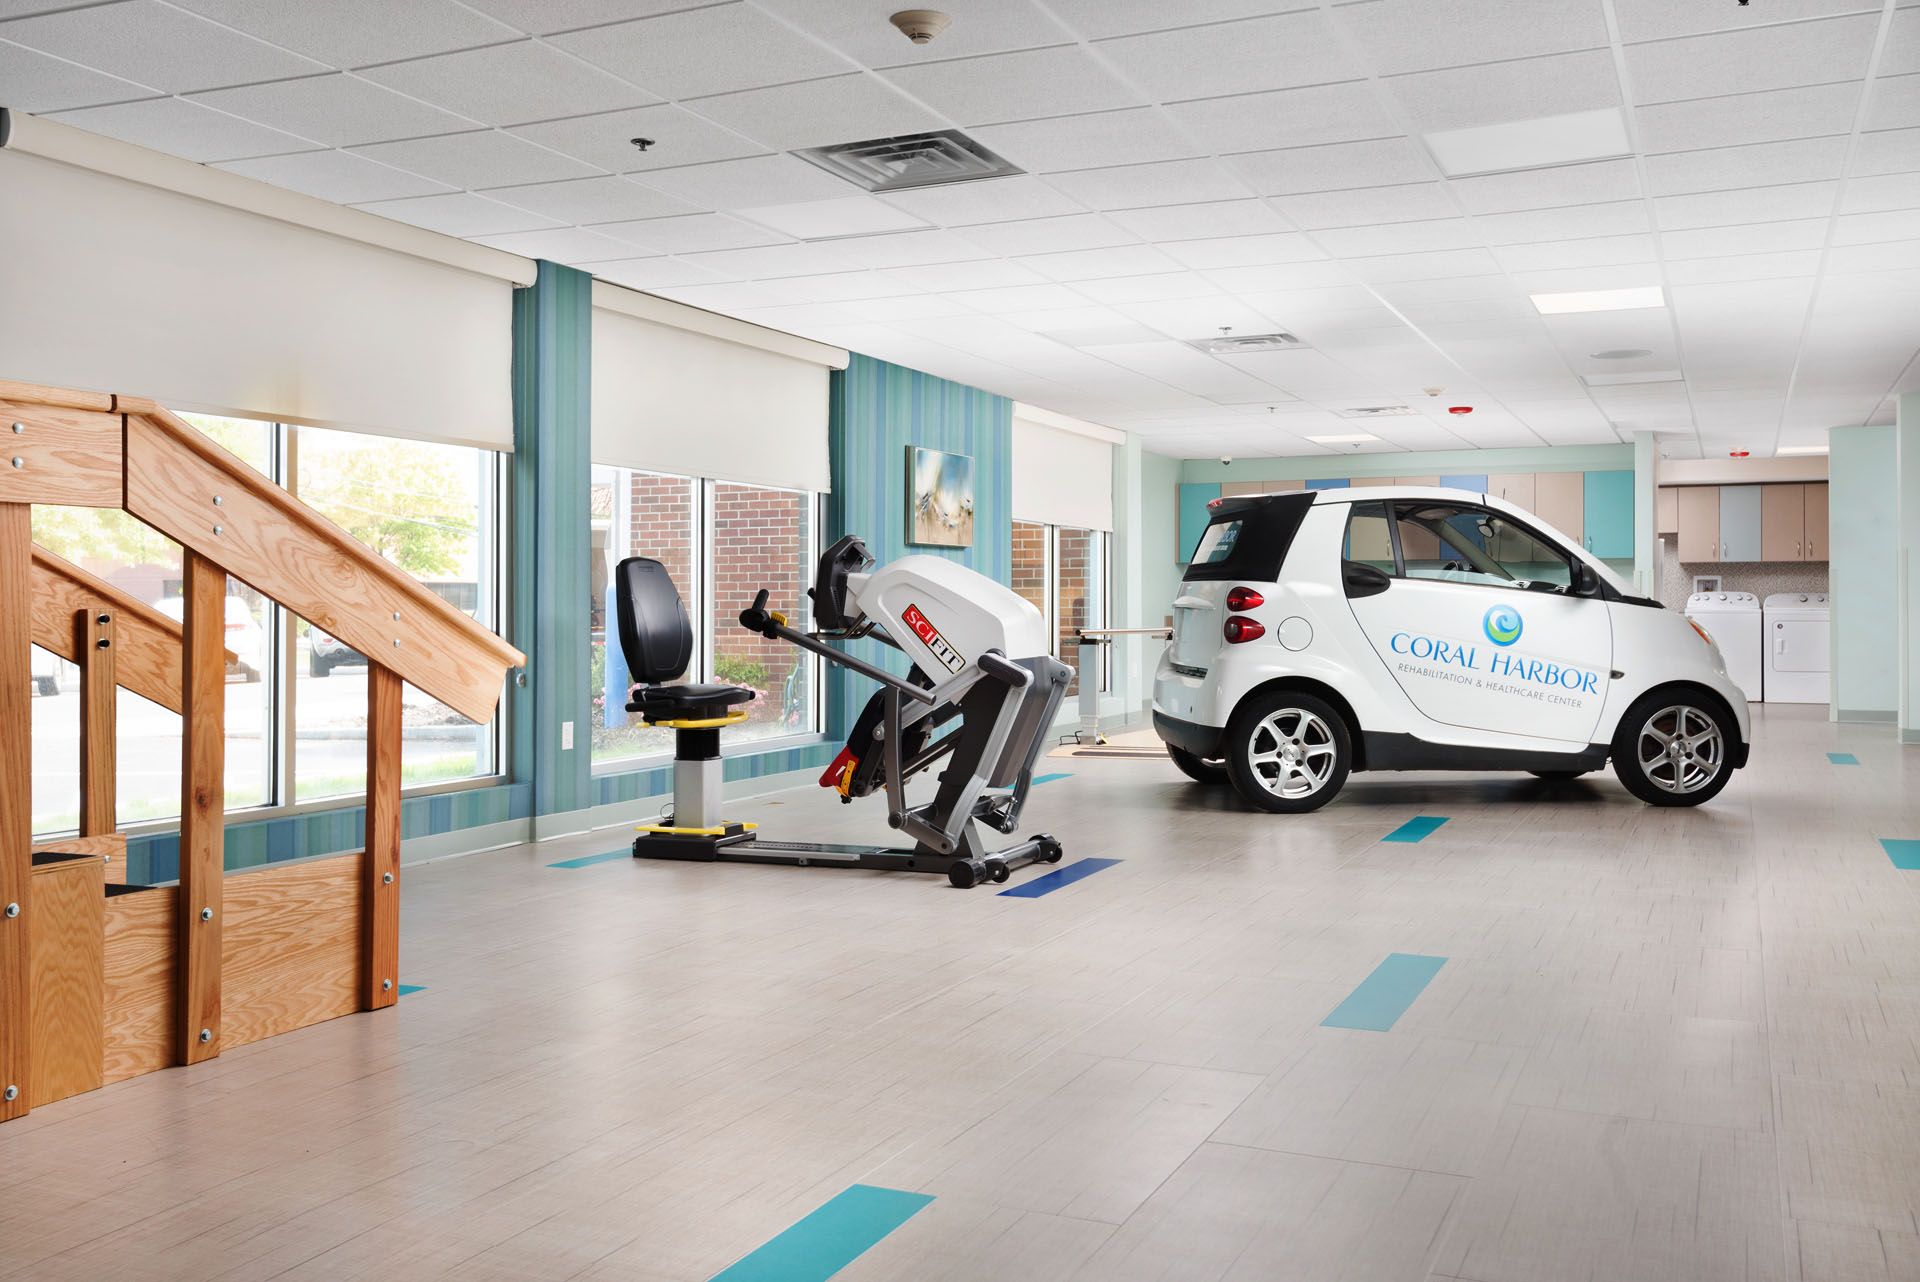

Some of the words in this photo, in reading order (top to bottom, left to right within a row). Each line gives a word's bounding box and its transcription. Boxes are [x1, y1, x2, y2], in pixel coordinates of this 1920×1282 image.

[906, 610, 960, 665] SCIFIT
[1390, 632, 1480, 670] CORAL
[1490, 652, 1598, 695] HARBOR
[1397, 662, 1473, 686] REHABILITATION
[1475, 679, 1483, 688] &
[1485, 681, 1545, 702] HEALTHCARE
[1547, 694, 1583, 709] CENTER
